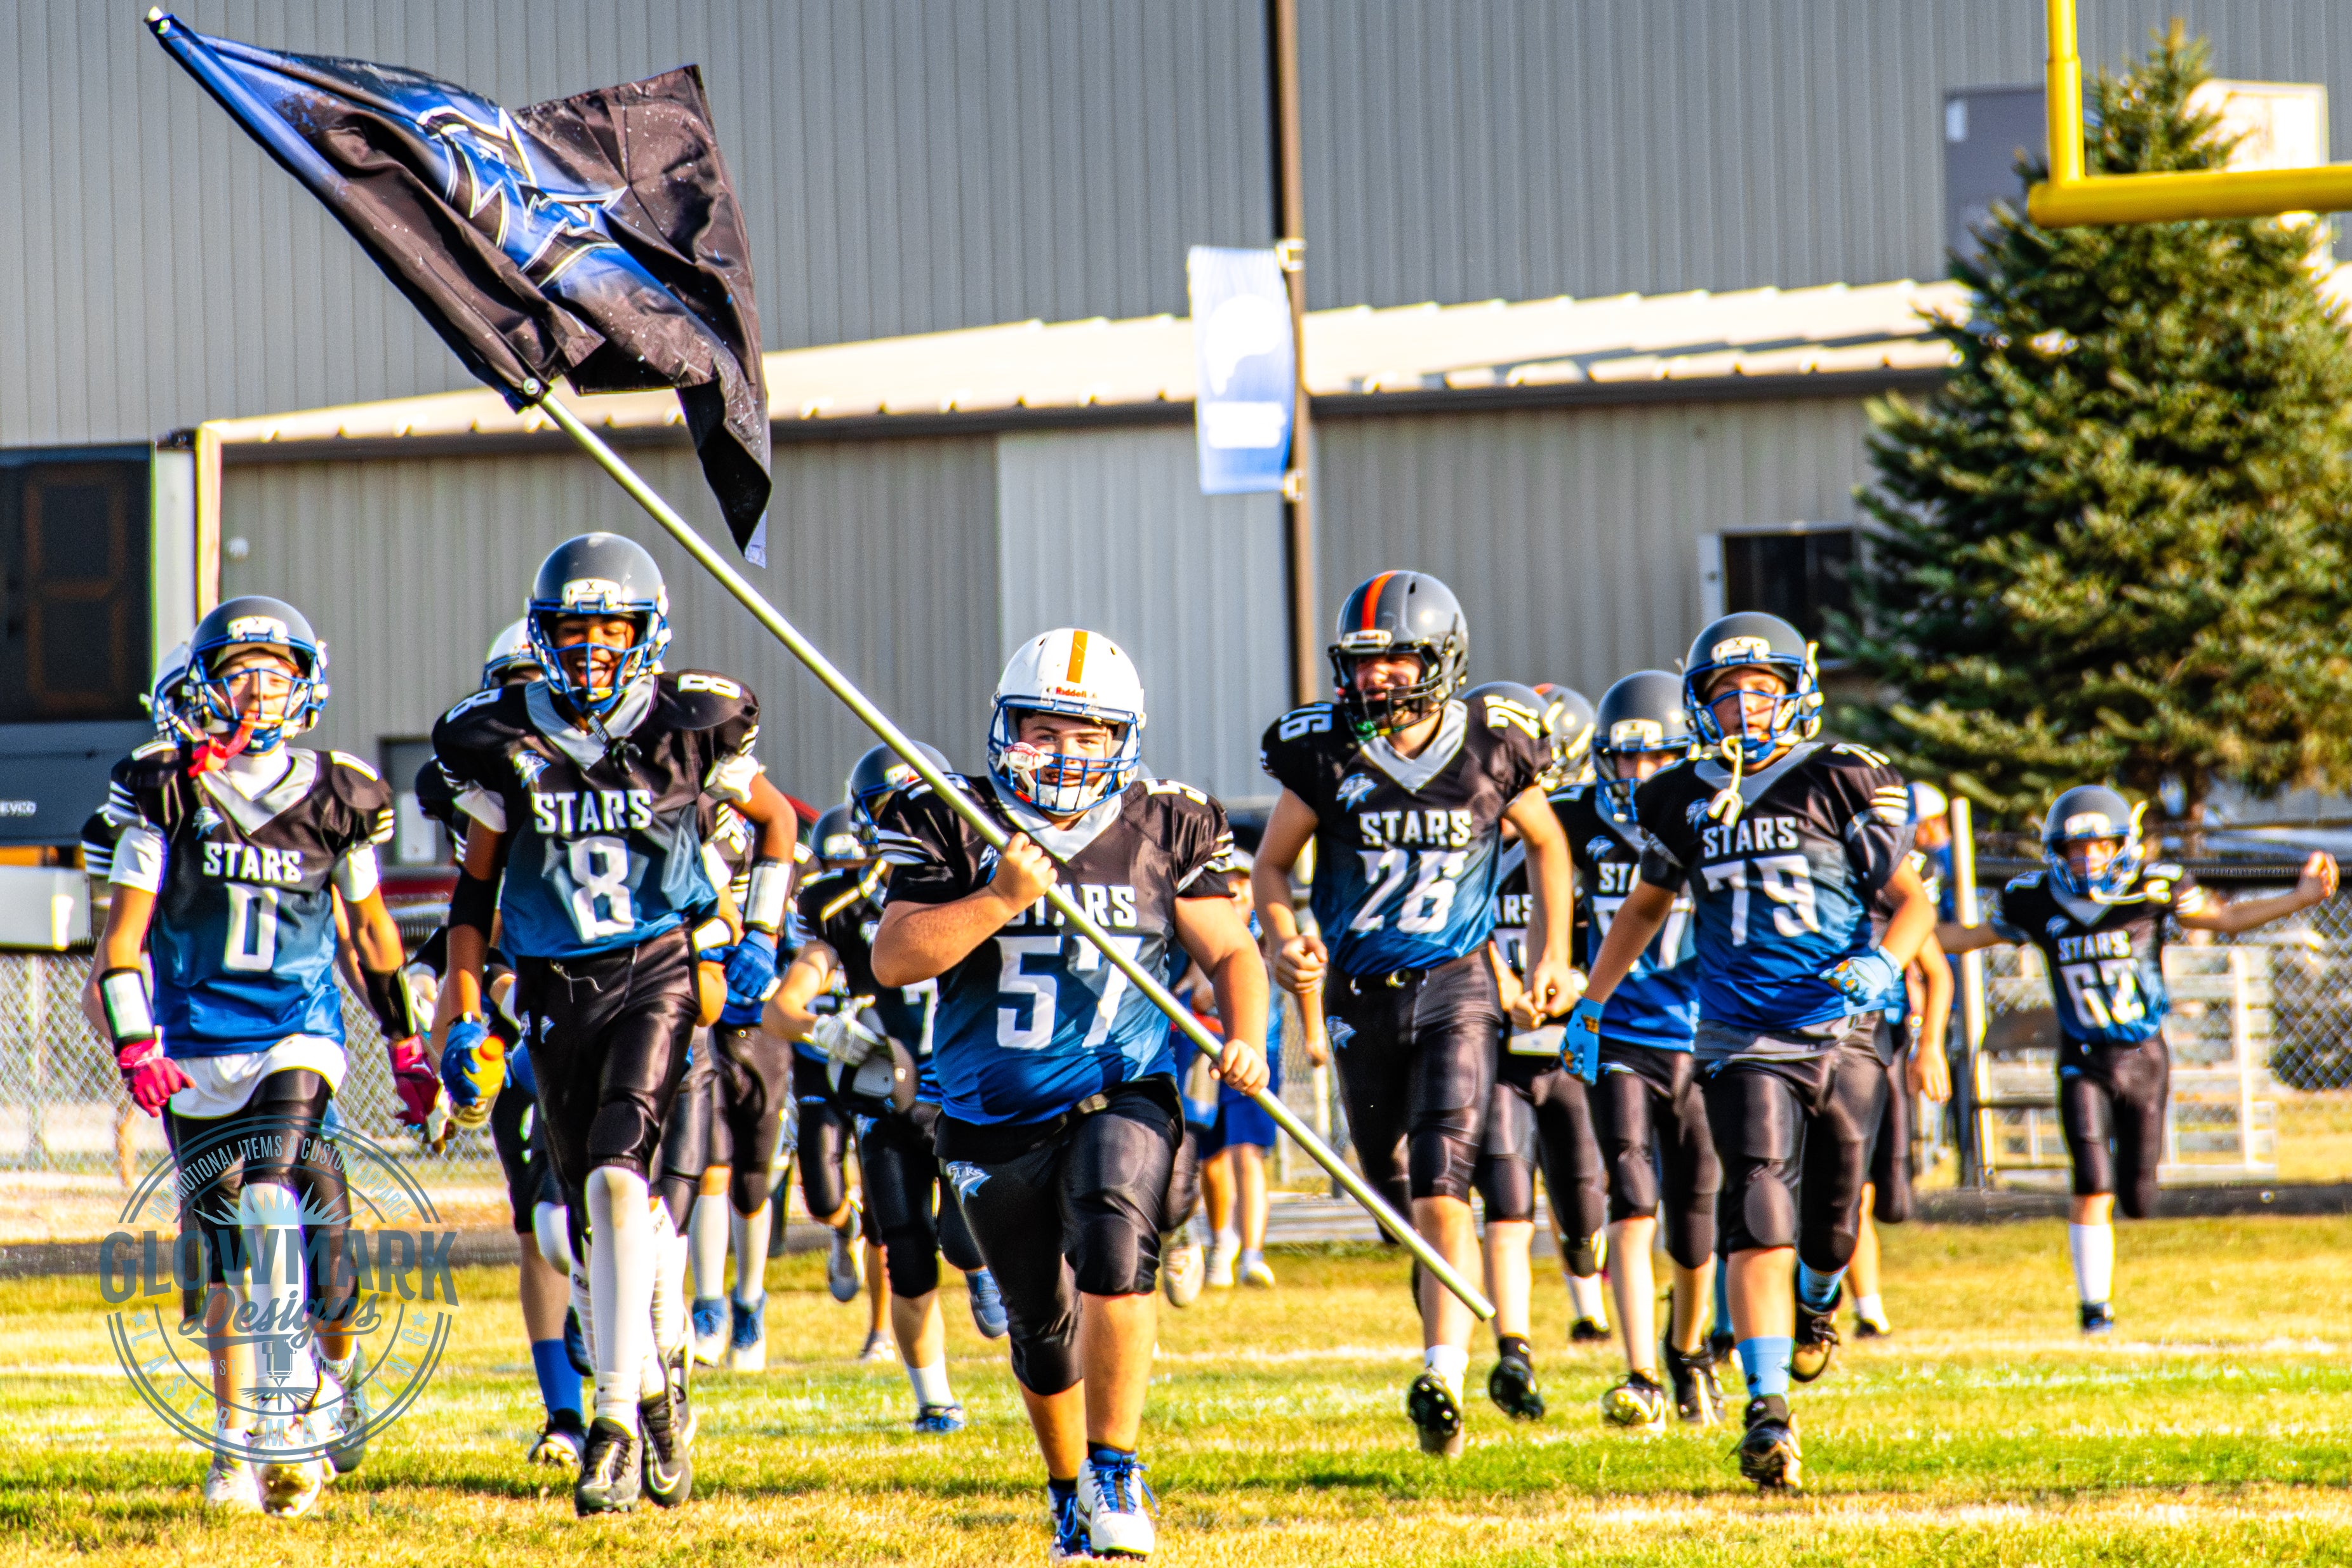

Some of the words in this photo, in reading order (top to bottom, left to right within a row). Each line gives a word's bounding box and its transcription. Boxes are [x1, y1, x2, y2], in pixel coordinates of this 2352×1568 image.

[1055, 686, 1087, 698] Riddell
[531, 789, 653, 834] STARS
[1359, 810, 1472, 847] STARS
[1702, 816, 1800, 858] STARS
[203, 842, 303, 883] STARS
[564, 836, 635, 941] 8
[1349, 849, 1470, 934] 26
[1701, 854, 1821, 947] 79
[223, 881, 279, 971] 0
[2058, 929, 2132, 962] STARS
[993, 934, 1144, 1050] 57
